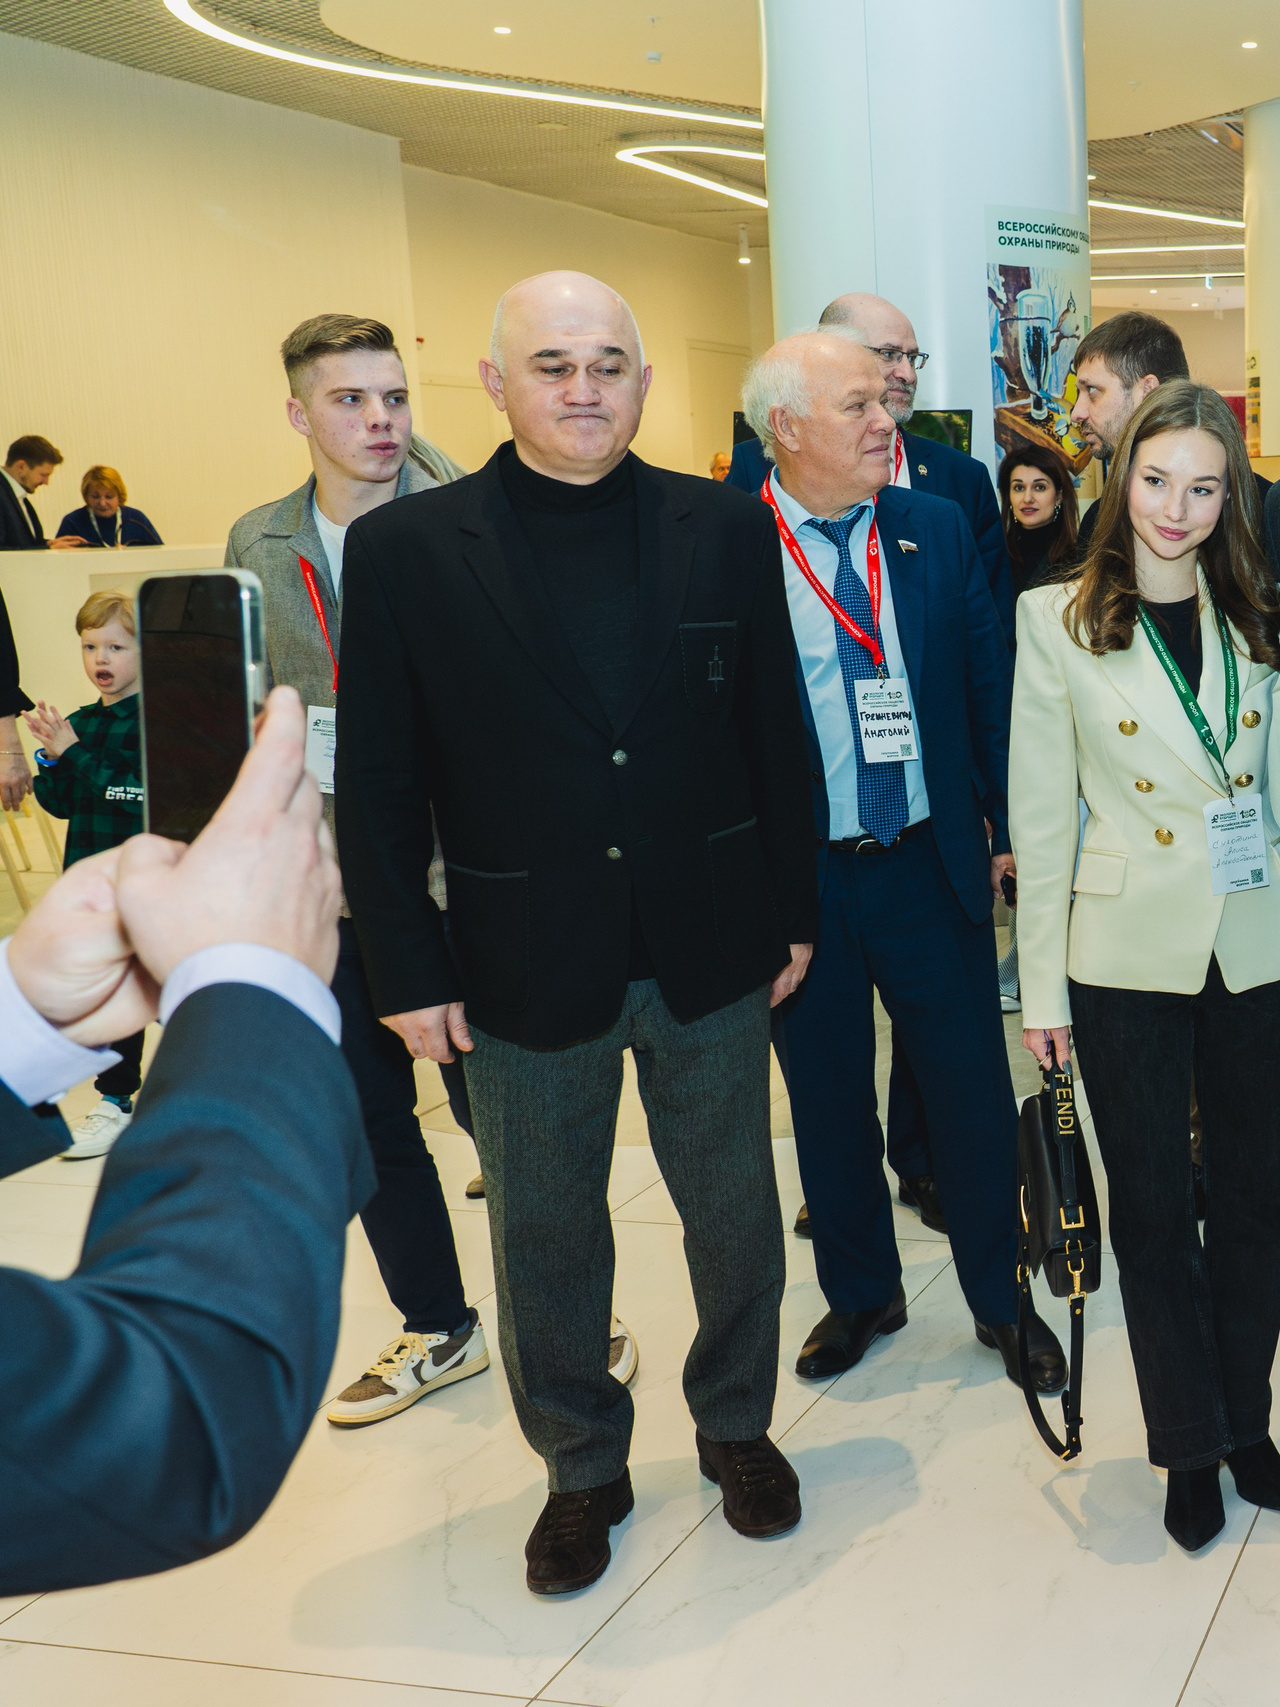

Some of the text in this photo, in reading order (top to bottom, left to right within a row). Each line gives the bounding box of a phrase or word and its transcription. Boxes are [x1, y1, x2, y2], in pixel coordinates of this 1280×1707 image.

[998, 220, 1079, 239] ВСЕРОССИЙСКОМУ
[998, 236, 1080, 254] ОХРАНЫ ПРИРОДЫ
[832, 605, 863, 638] ВСЕРОССИЙСКОЕ
[1161, 652, 1175, 671] ОХРАНЫ
[1172, 670, 1187, 694] ПРИРОДЫ
[1188, 701, 1200, 717] ВООП
[1054, 1073, 1075, 1135] FENDI
